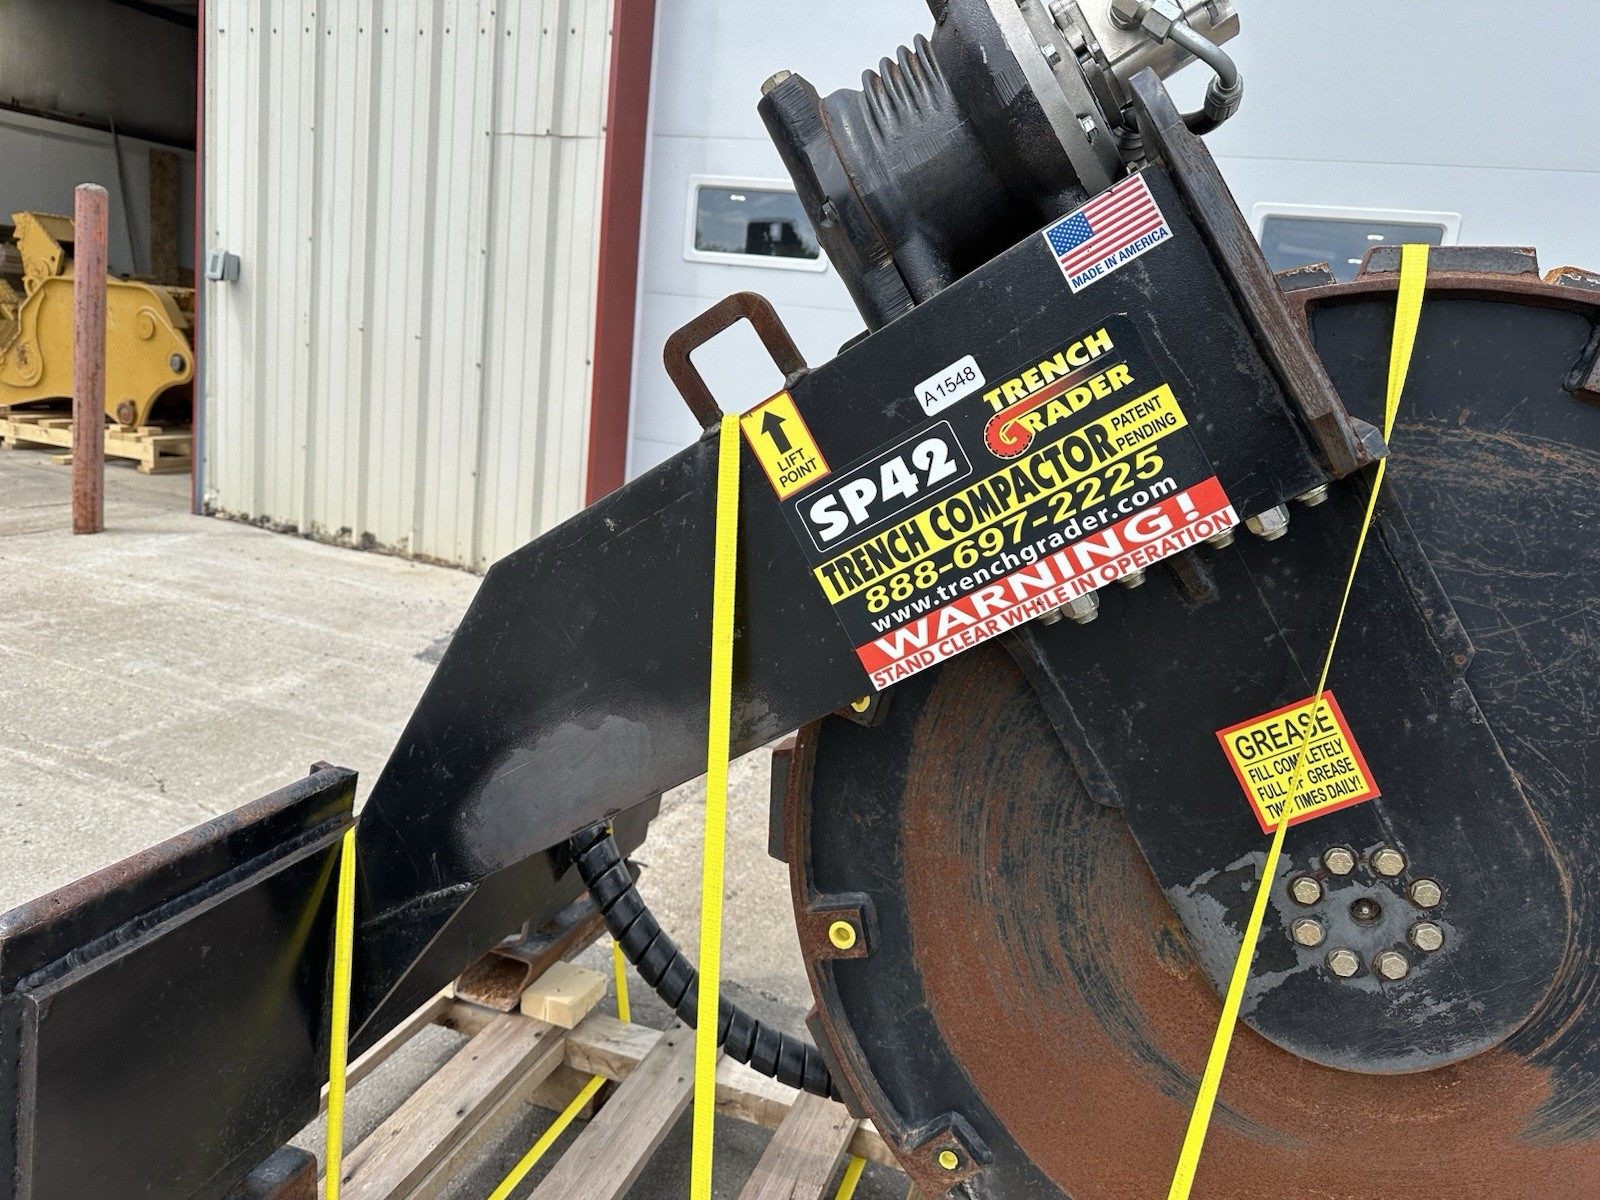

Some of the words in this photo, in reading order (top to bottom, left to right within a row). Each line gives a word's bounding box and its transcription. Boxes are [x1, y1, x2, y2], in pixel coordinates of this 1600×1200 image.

[1071, 263, 1105, 289] MADE
[1103, 255, 1118, 269] IN
[1118, 227, 1169, 262] AMERICA
[982, 328, 1115, 412] TRENCH
[984, 363, 1135, 459] GRADER
[1111, 395, 1163, 431] PATENT
[1116, 411, 1177, 453] PENDING
[777, 448, 806, 472] LIFT
[779, 457, 818, 488] POINT
[809, 437, 958, 542] SP42
[821, 519, 930, 598] TRENCH
[930, 423, 1118, 541] COMPACTOR
[865, 445, 1164, 614] 888-697-2225
[871, 476, 1178, 633] www.trenchgrader.com
[873, 491, 1200, 661] WARNING!
[873, 650, 935, 688] STAND
[938, 618, 1002, 657] CLEAR
[1001, 586, 1070, 627] WHILE
[1071, 573, 1098, 597] IN
[1100, 509, 1233, 582] OPERATION
[1235, 706, 1334, 760] GREASE
[1248, 765, 1274, 783] FILL
[1273, 738, 1344, 775] COMLETELY
[1257, 781, 1287, 802] FULL
[1307, 757, 1355, 784] GREASE
[1294, 788, 1327, 811] TIMES
[1326, 775, 1363, 799] DAILY!
